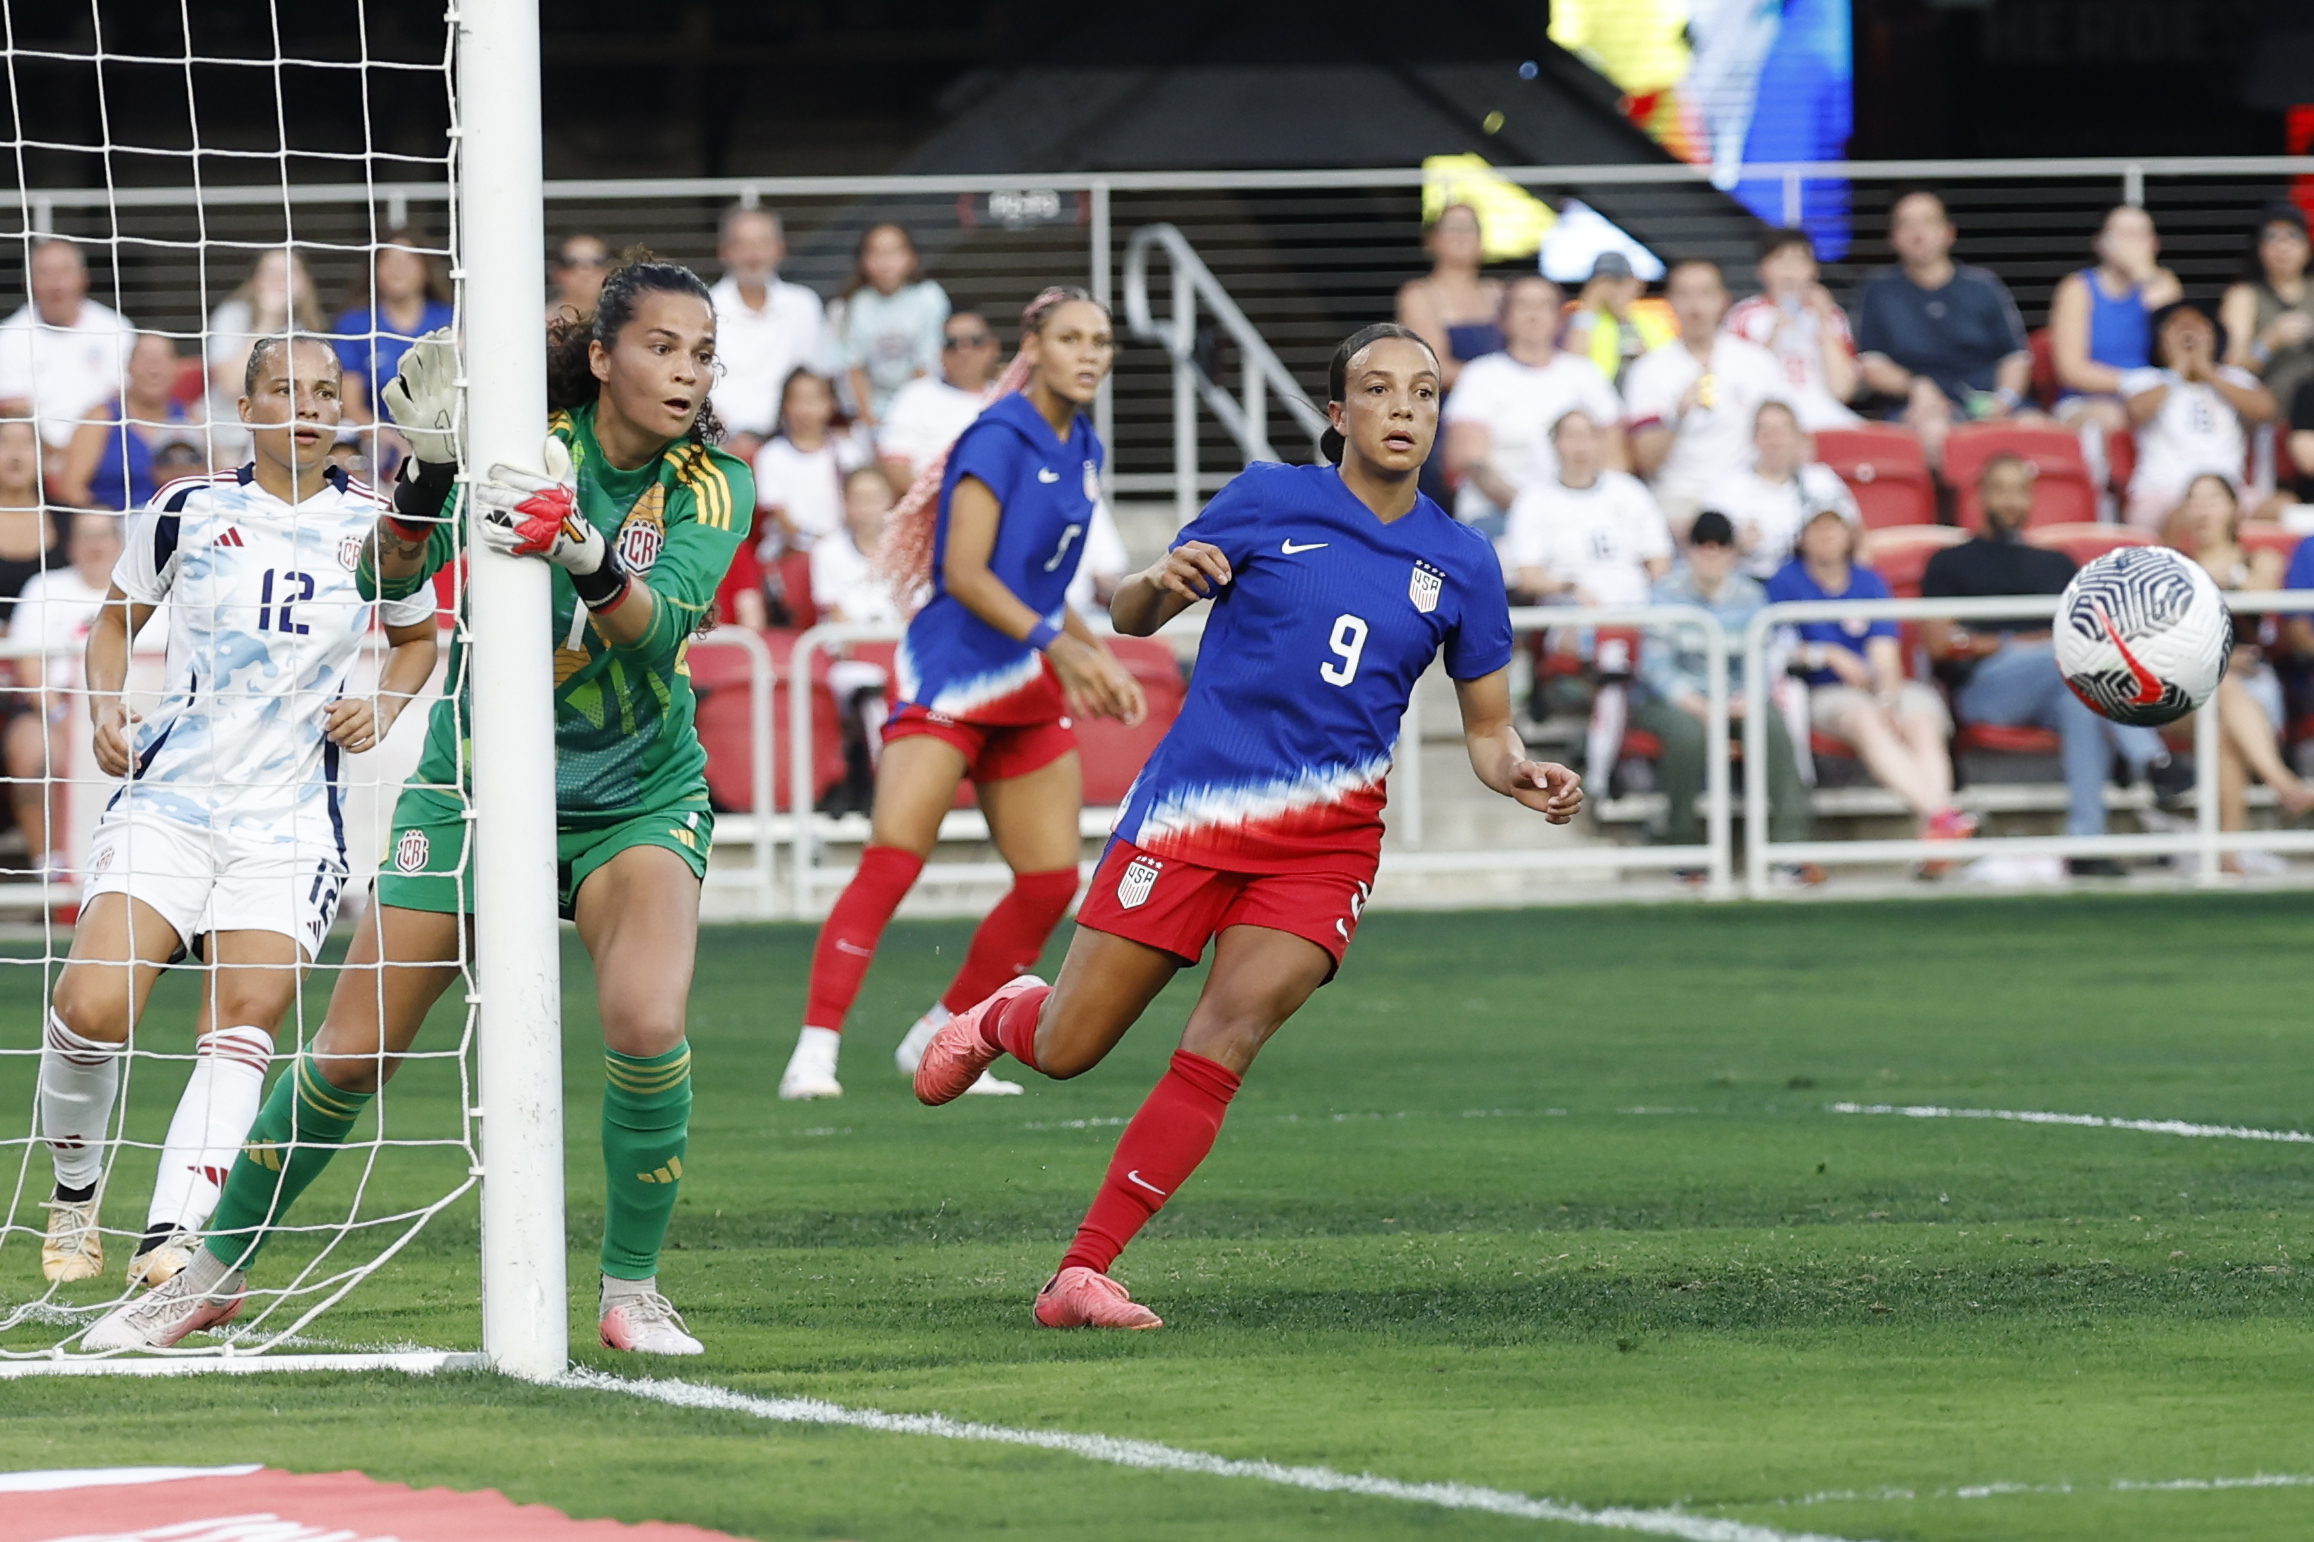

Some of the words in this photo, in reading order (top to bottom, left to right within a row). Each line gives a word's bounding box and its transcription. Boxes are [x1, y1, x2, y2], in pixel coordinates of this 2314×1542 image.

[628, 530, 654, 566] CR
[1414, 569, 1439, 591] USA
[258, 568, 315, 635] 12
[1319, 613, 1369, 688] 9
[403, 839, 421, 866] CR
[1128, 864, 1155, 884] USA
